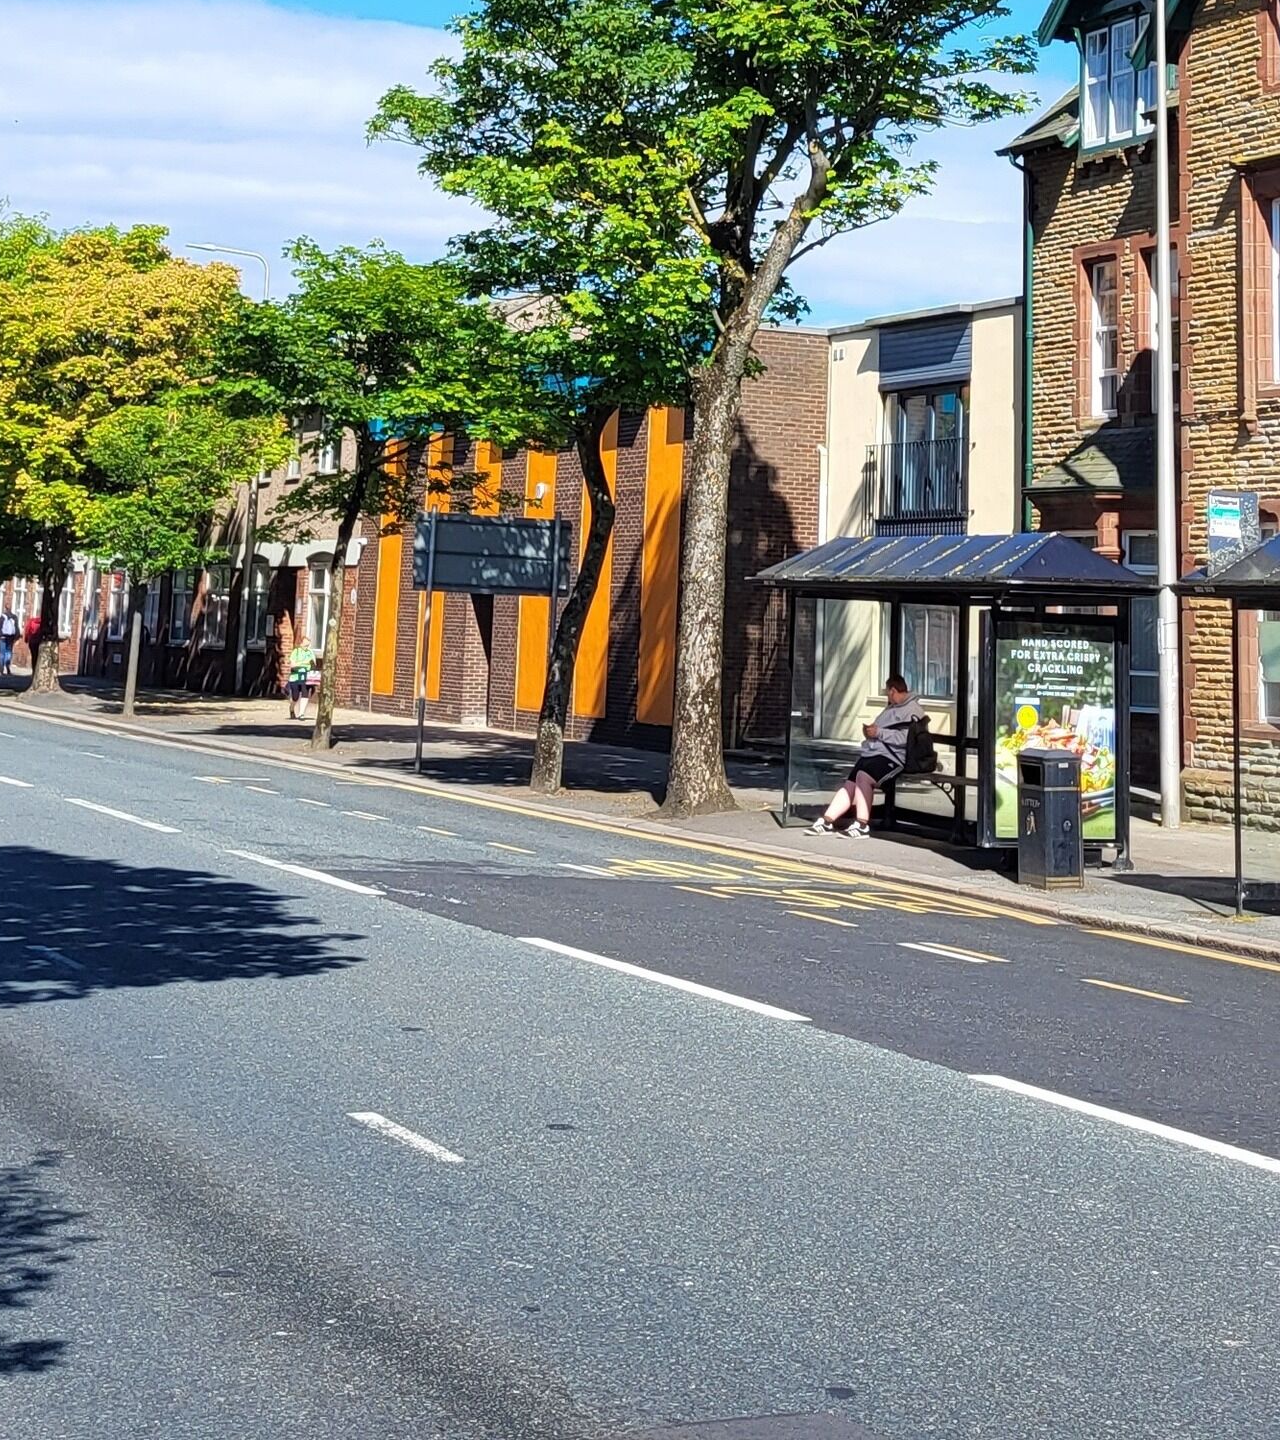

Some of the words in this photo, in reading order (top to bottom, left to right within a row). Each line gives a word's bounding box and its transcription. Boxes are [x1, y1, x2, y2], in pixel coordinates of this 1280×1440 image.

[1021, 638, 1048, 648] HAND
[1050, 640, 1090, 650] SCORED
[1010, 649, 1031, 659] FOR
[1033, 651, 1065, 661] EXTRA
[1067, 652, 1101, 663] CRISPY
[1027, 663, 1084, 675] CRACKLING
[707, 885, 1001, 920] BUS
